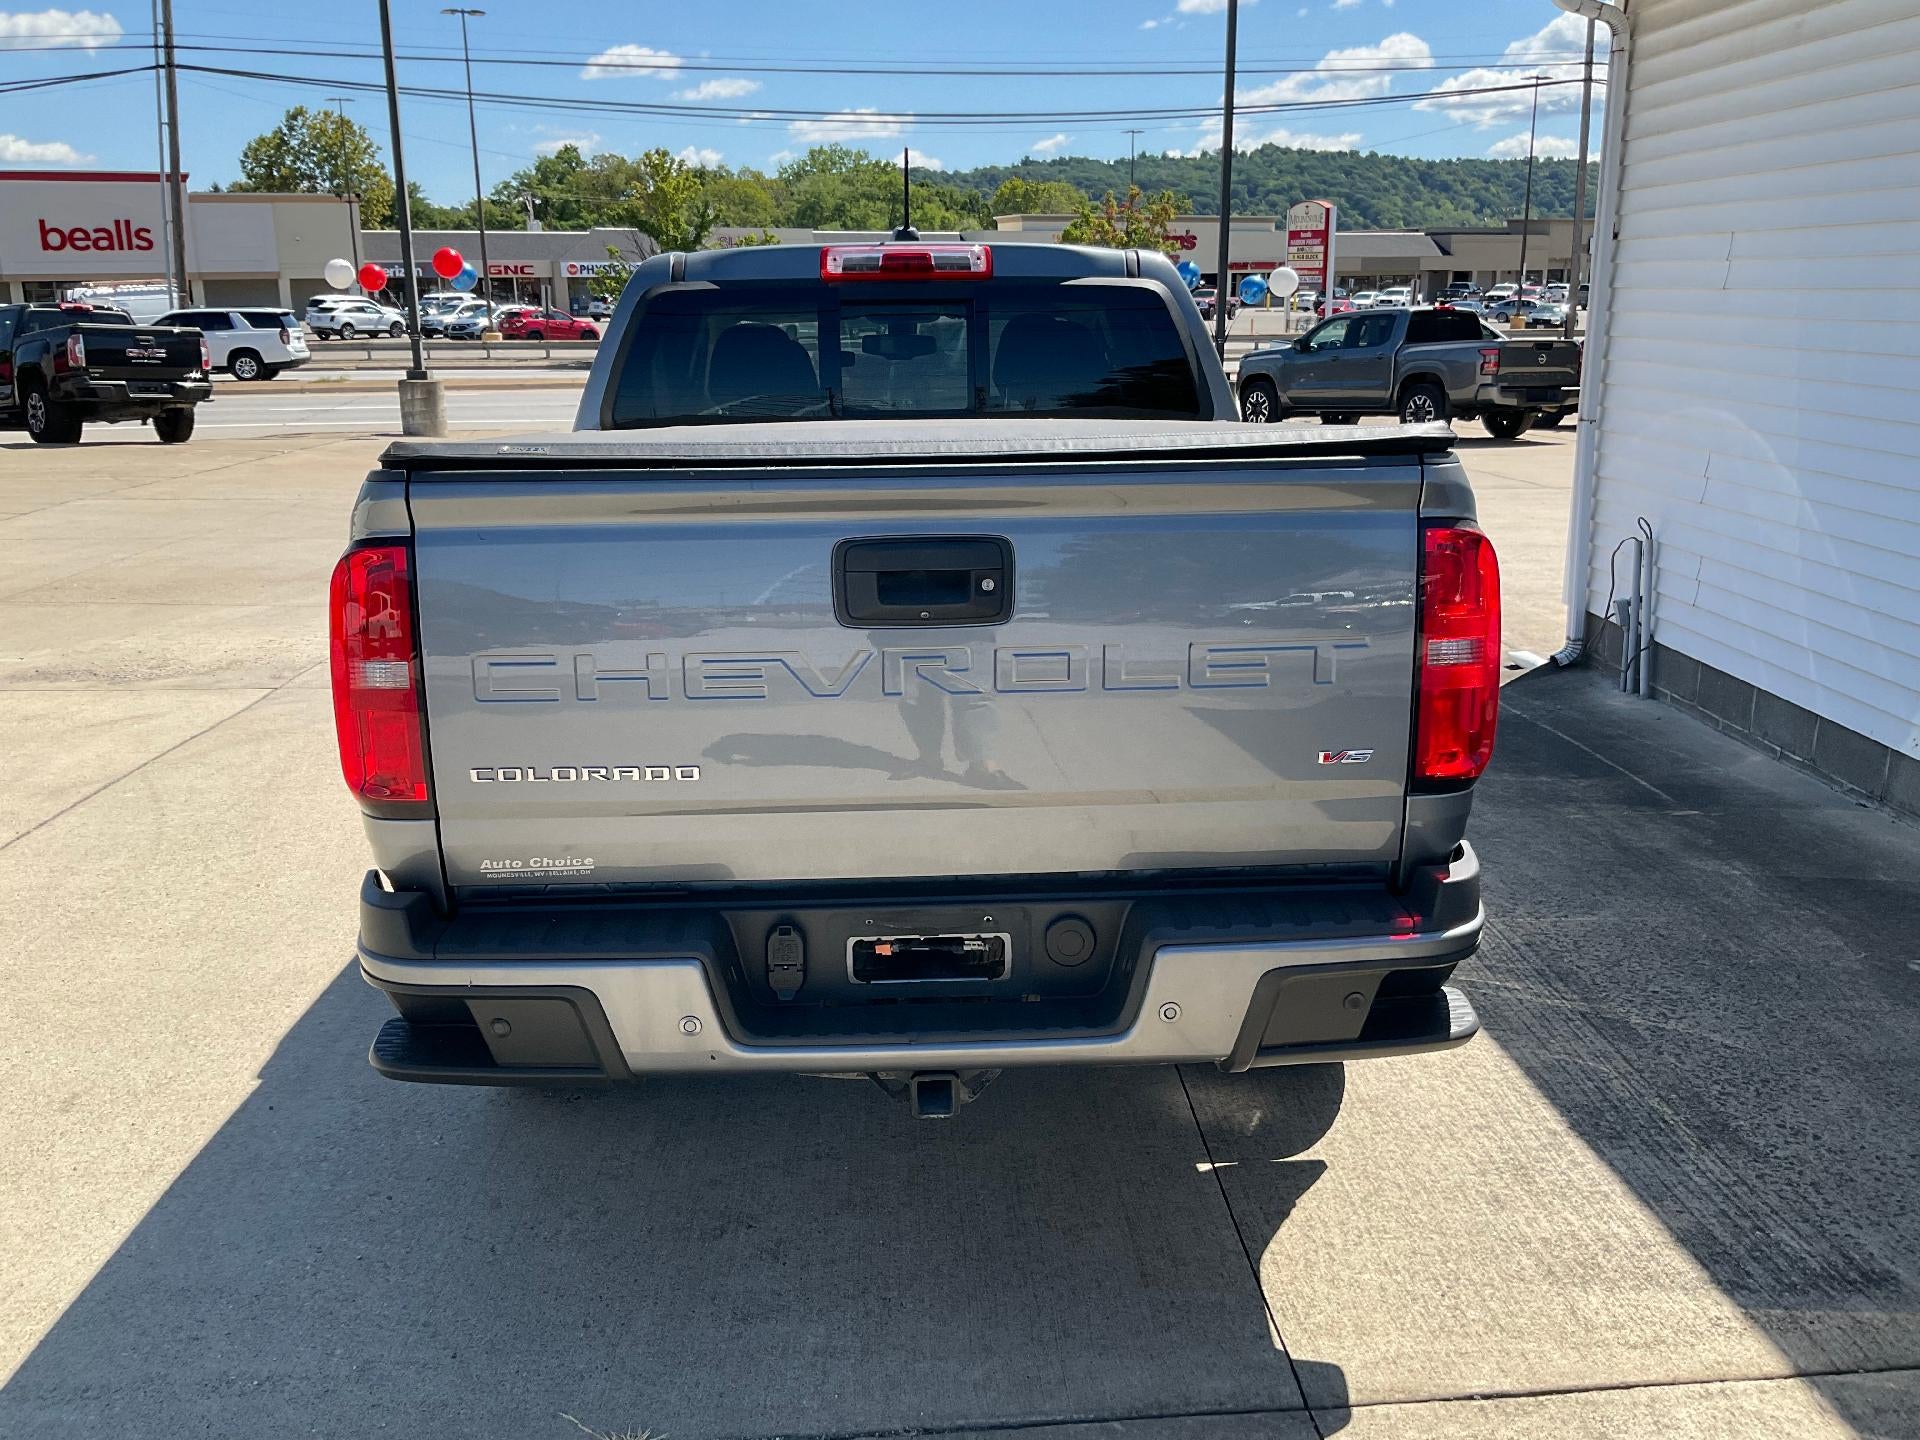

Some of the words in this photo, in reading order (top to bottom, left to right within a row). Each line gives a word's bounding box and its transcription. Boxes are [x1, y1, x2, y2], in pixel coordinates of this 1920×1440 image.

[38, 218, 154, 251] bealls
[384, 264, 423, 278] erizn
[488, 264, 534, 275] GNC
[471, 636, 1370, 702] CHEVROLET
[1317, 749, 1374, 764] V6
[469, 765, 700, 783] COLORADO
[480, 859, 523, 869] Auto
[529, 856, 594, 868] Choice
